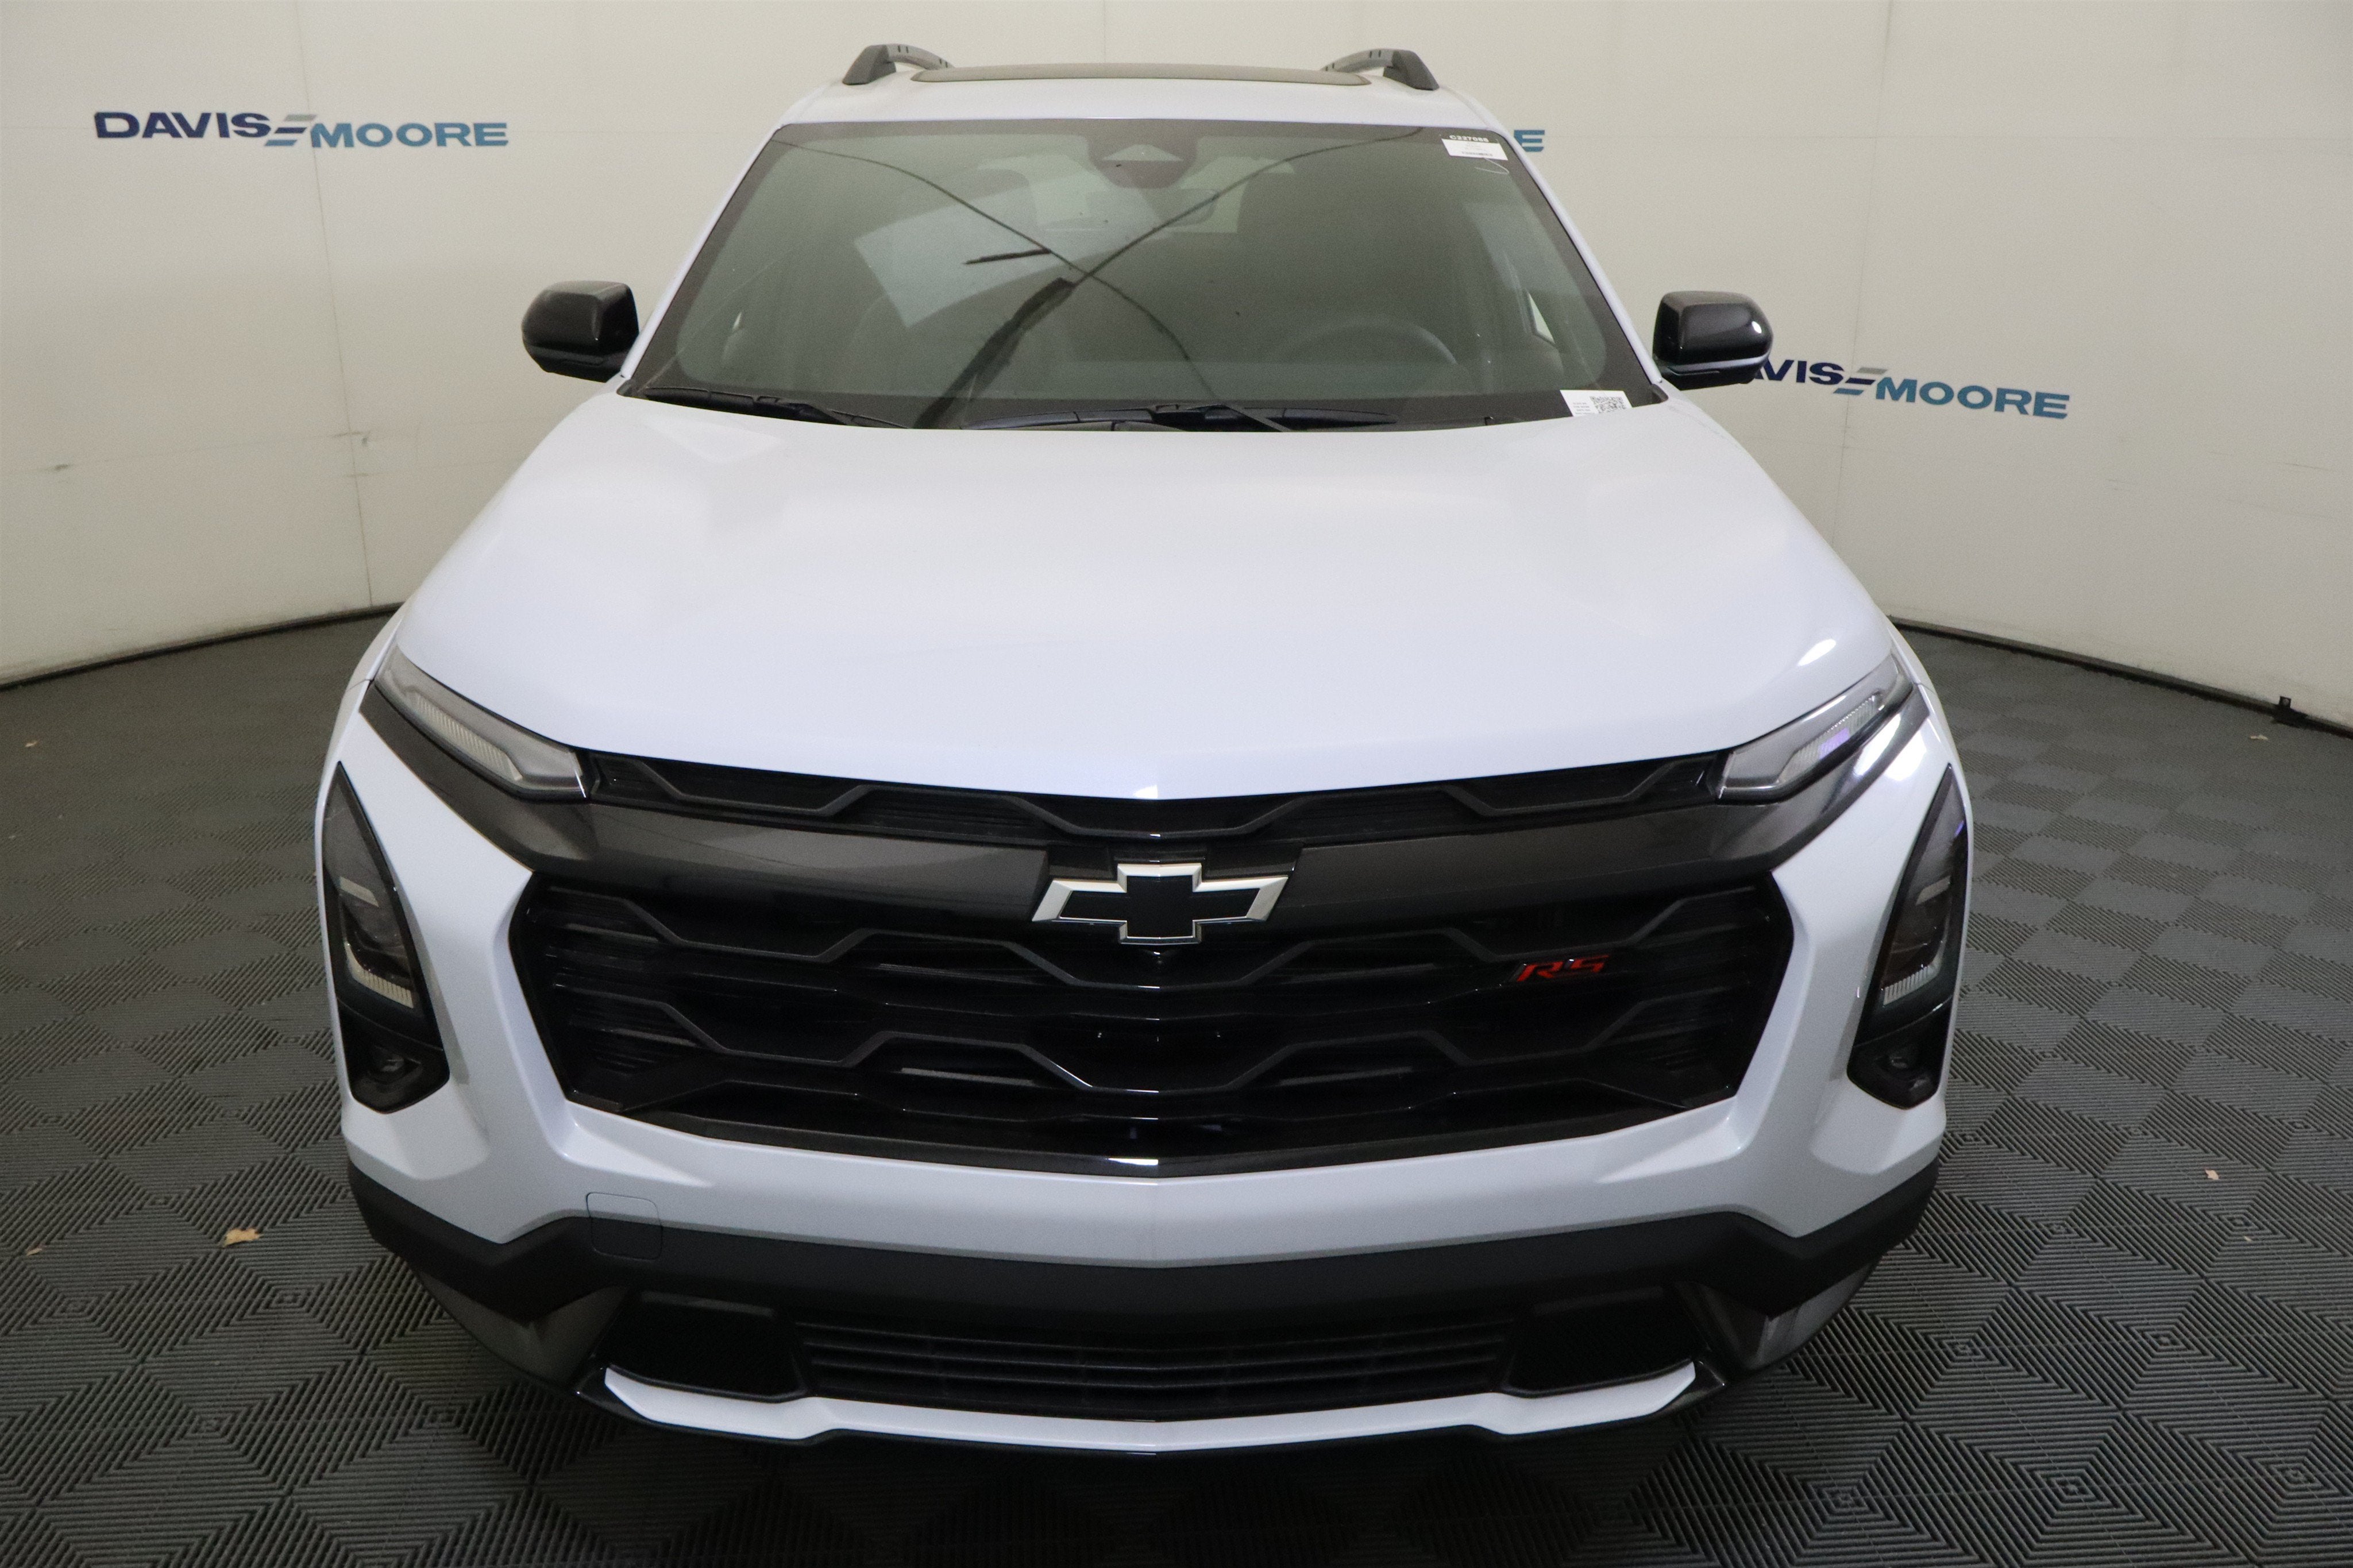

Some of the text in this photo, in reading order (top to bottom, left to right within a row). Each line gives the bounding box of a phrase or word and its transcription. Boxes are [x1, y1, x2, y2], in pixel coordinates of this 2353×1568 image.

[94, 111, 509, 148] DAVIS MOORE
[1754, 357, 2070, 420] VIS MOORE
[1515, 955, 1610, 982] RS
